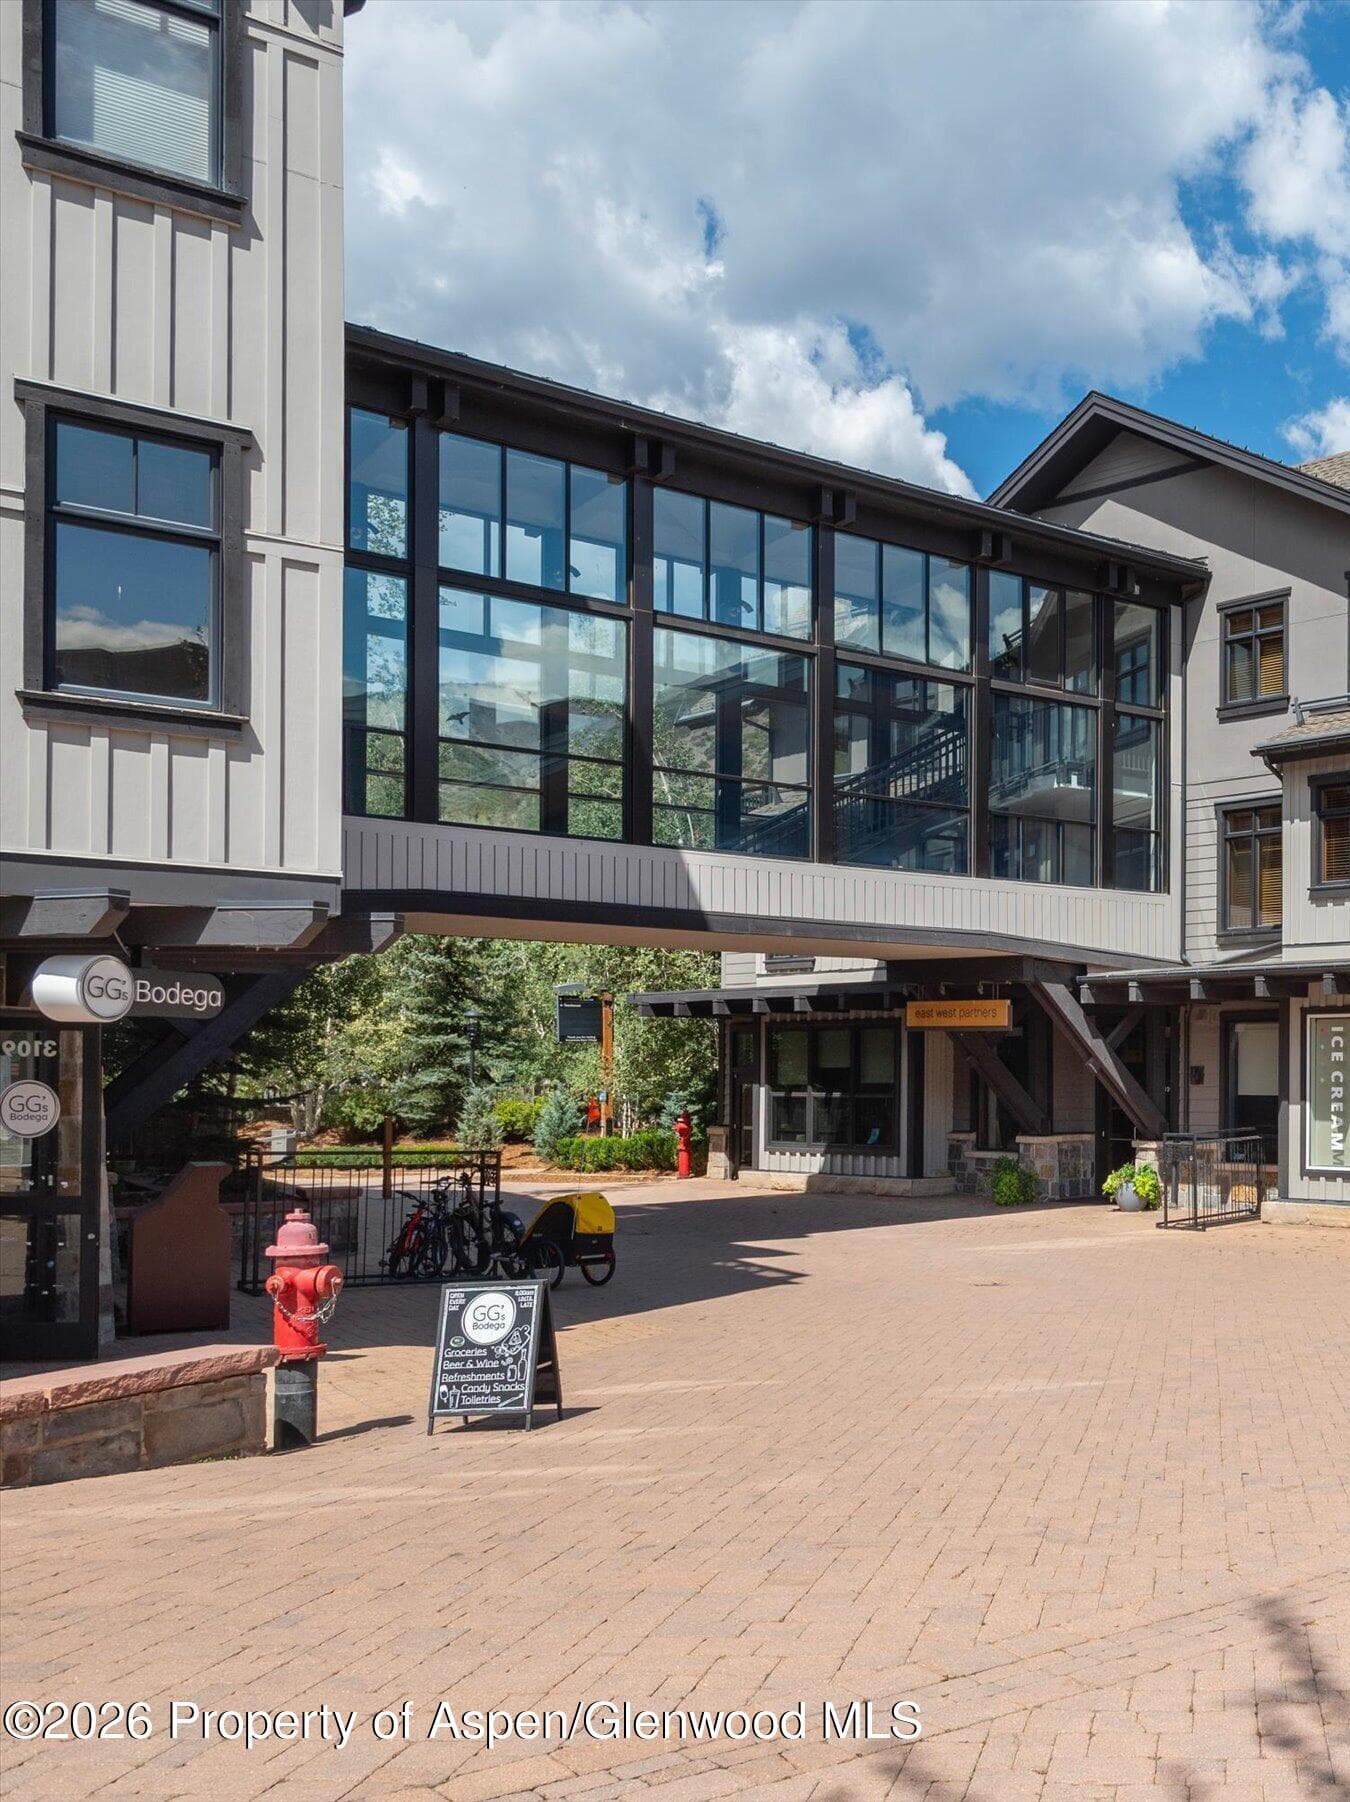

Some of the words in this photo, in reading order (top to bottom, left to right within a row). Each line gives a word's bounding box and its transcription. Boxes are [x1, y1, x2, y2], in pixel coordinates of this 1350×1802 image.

[87, 975, 129, 1001] GG's
[136, 979, 222, 1012] Bodega
[915, 1007, 934, 1019] east
[936, 1007, 957, 1018] west
[959, 1007, 997, 1020] partners
[1331, 1026, 1344, 1062] ICE
[9, 1095, 48, 1113] GG's
[1331, 1071, 1344, 1151] CREAM
[10, 1113, 48, 1122] Bodega
[473, 1304, 506, 1321] GG's
[472, 1322, 506, 1331] Bodega
[444, 1348, 488, 1358] Groceries
[442, 1360, 464, 1370] Beer
[466, 1360, 474, 1368] &
[475, 1360, 500, 1368] Wine
[441, 1372, 505, 1382] Refreshments
[461, 1384, 491, 1394] Candy
[492, 1382, 525, 1392] Snacks
[461, 1395, 501, 1405] Toiletries
